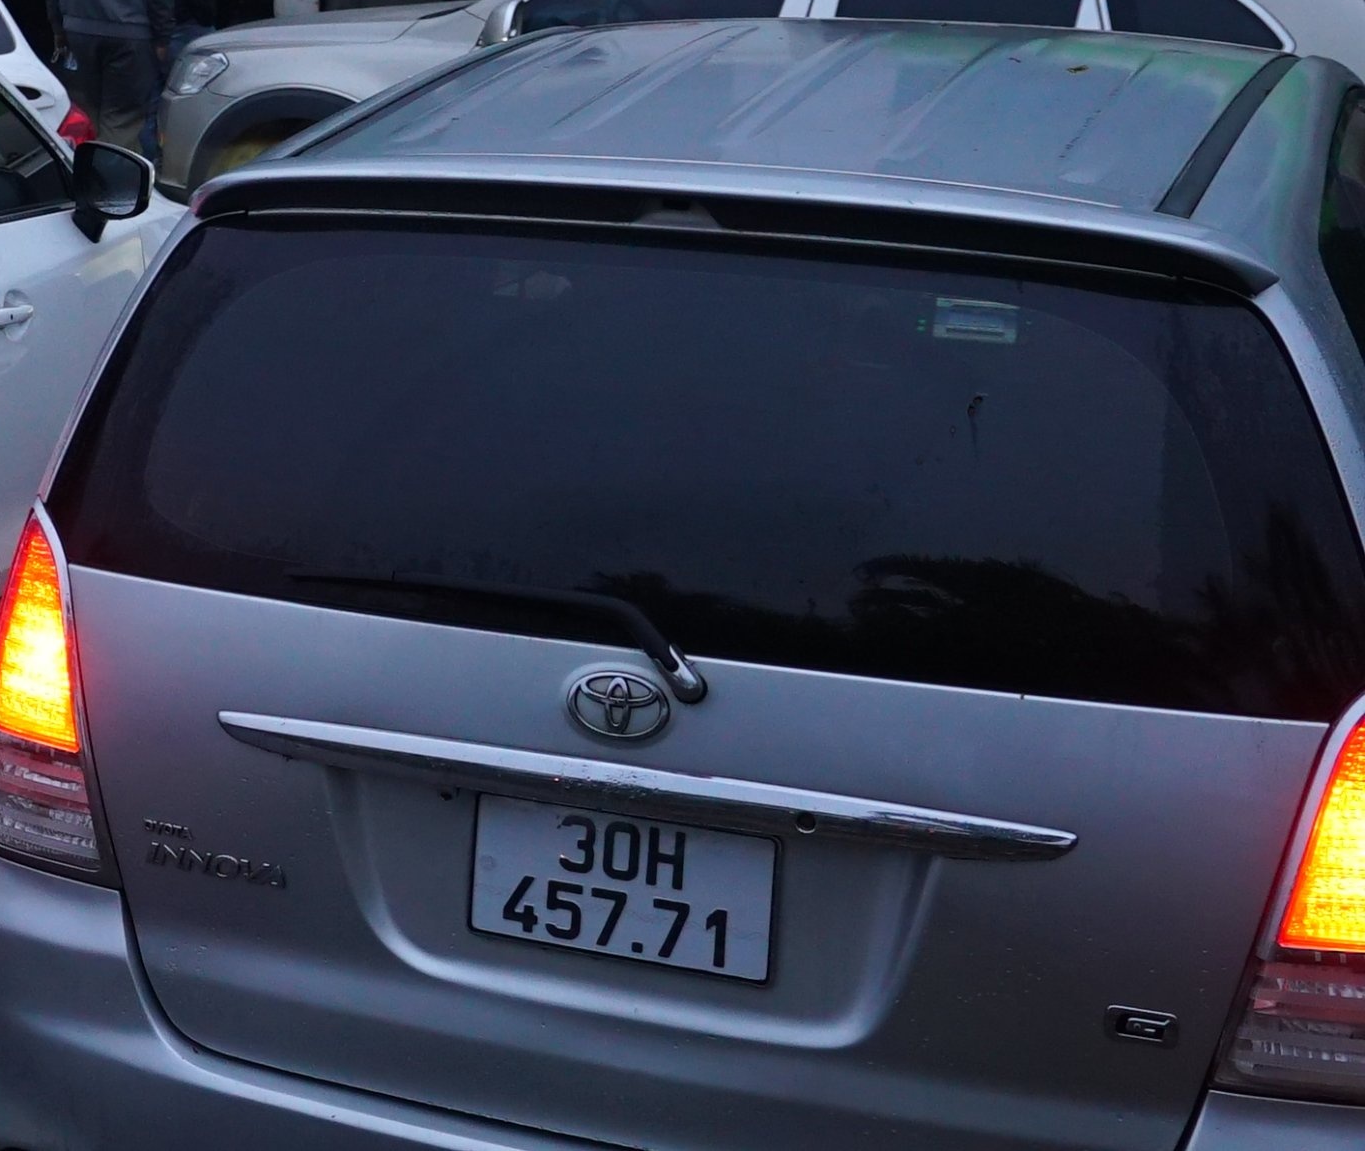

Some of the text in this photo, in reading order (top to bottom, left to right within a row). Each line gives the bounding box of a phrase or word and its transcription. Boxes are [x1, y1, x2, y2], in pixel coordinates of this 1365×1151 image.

[146, 841, 286, 889] INNOVA
[557, 816, 685, 892] 30H
[502, 875, 730, 969] 457.71
